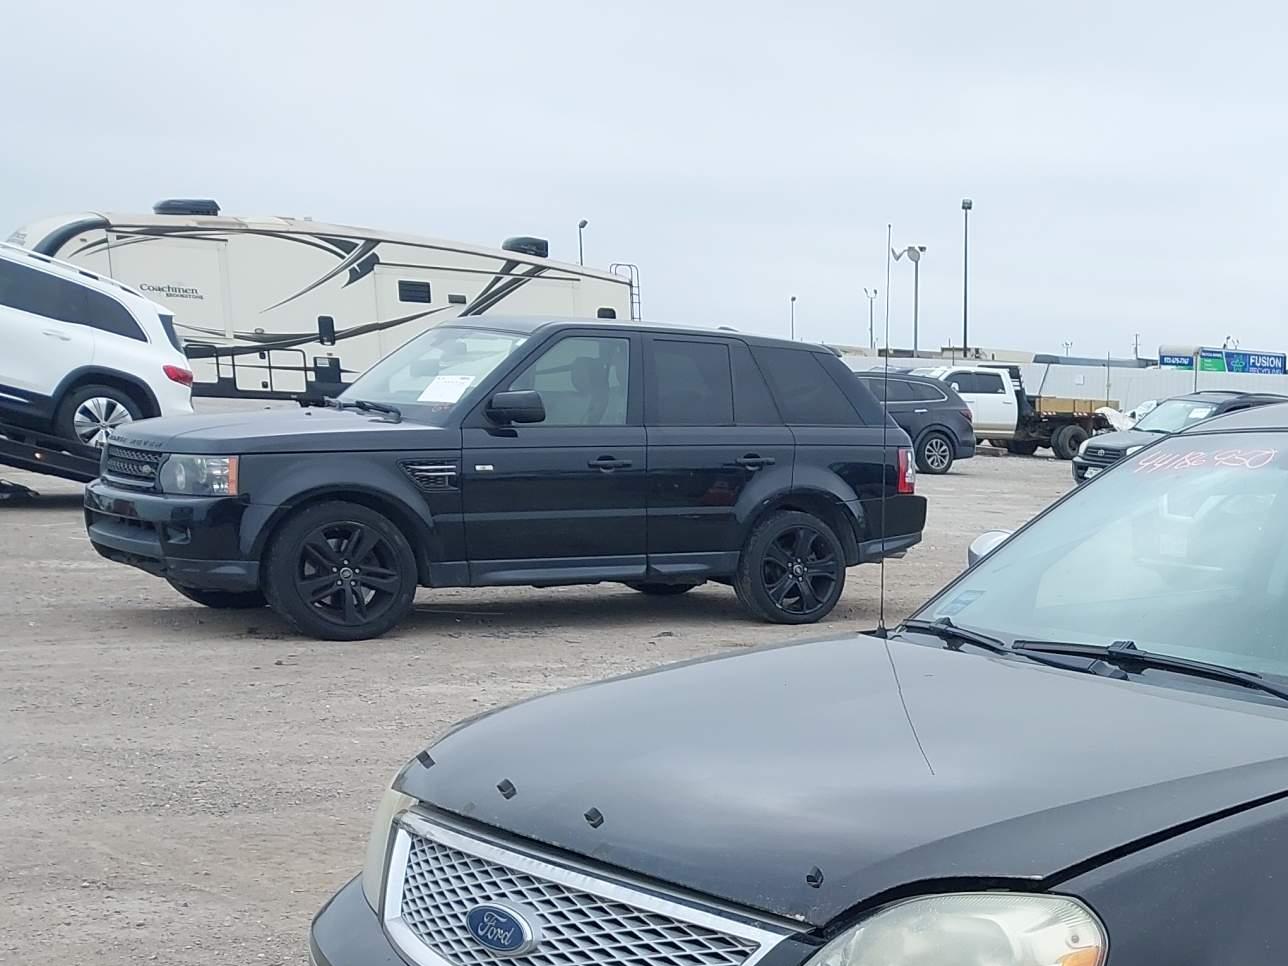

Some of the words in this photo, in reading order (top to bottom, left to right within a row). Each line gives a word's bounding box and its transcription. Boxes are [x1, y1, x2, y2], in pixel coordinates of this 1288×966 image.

[140, 283, 198, 294] Coachmen
[1249, 355, 1282, 368] FUSION
[478, 911, 515, 945] Ford
